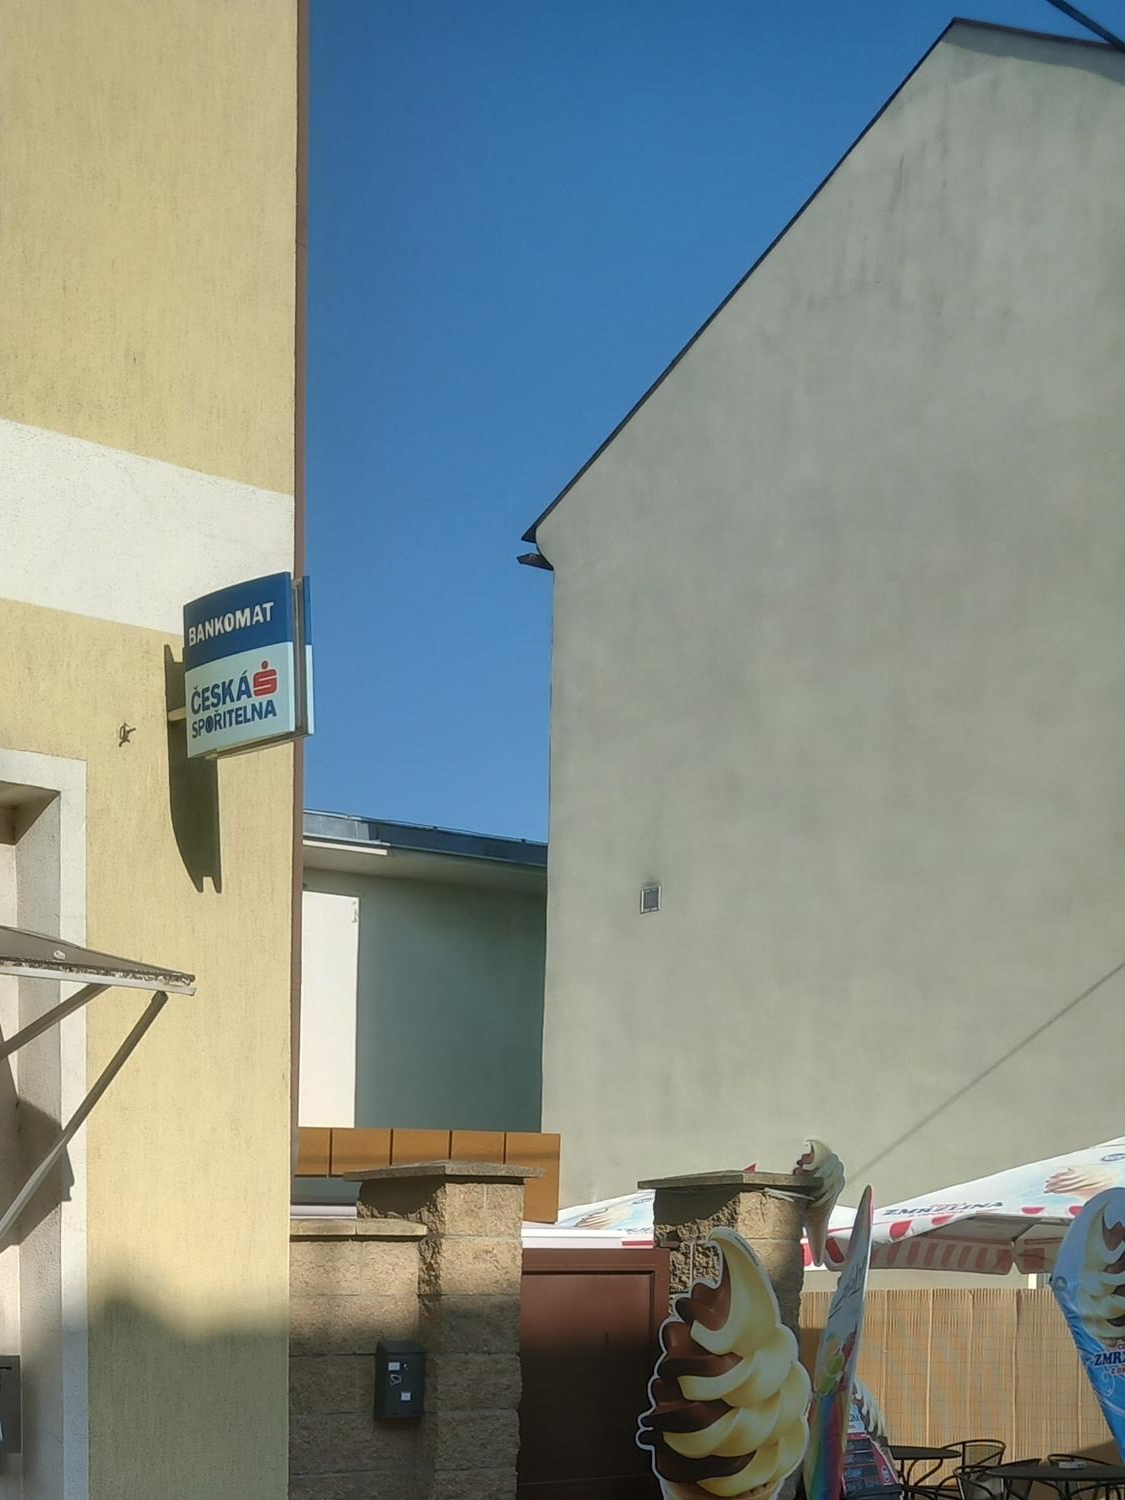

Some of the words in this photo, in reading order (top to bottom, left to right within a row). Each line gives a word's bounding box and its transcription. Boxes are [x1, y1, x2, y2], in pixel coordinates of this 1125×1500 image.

[188, 602, 274, 646] BANKOMAT
[191, 670, 252, 714] ČESKÁ
[192, 699, 277, 738] SPOŘITELNA
